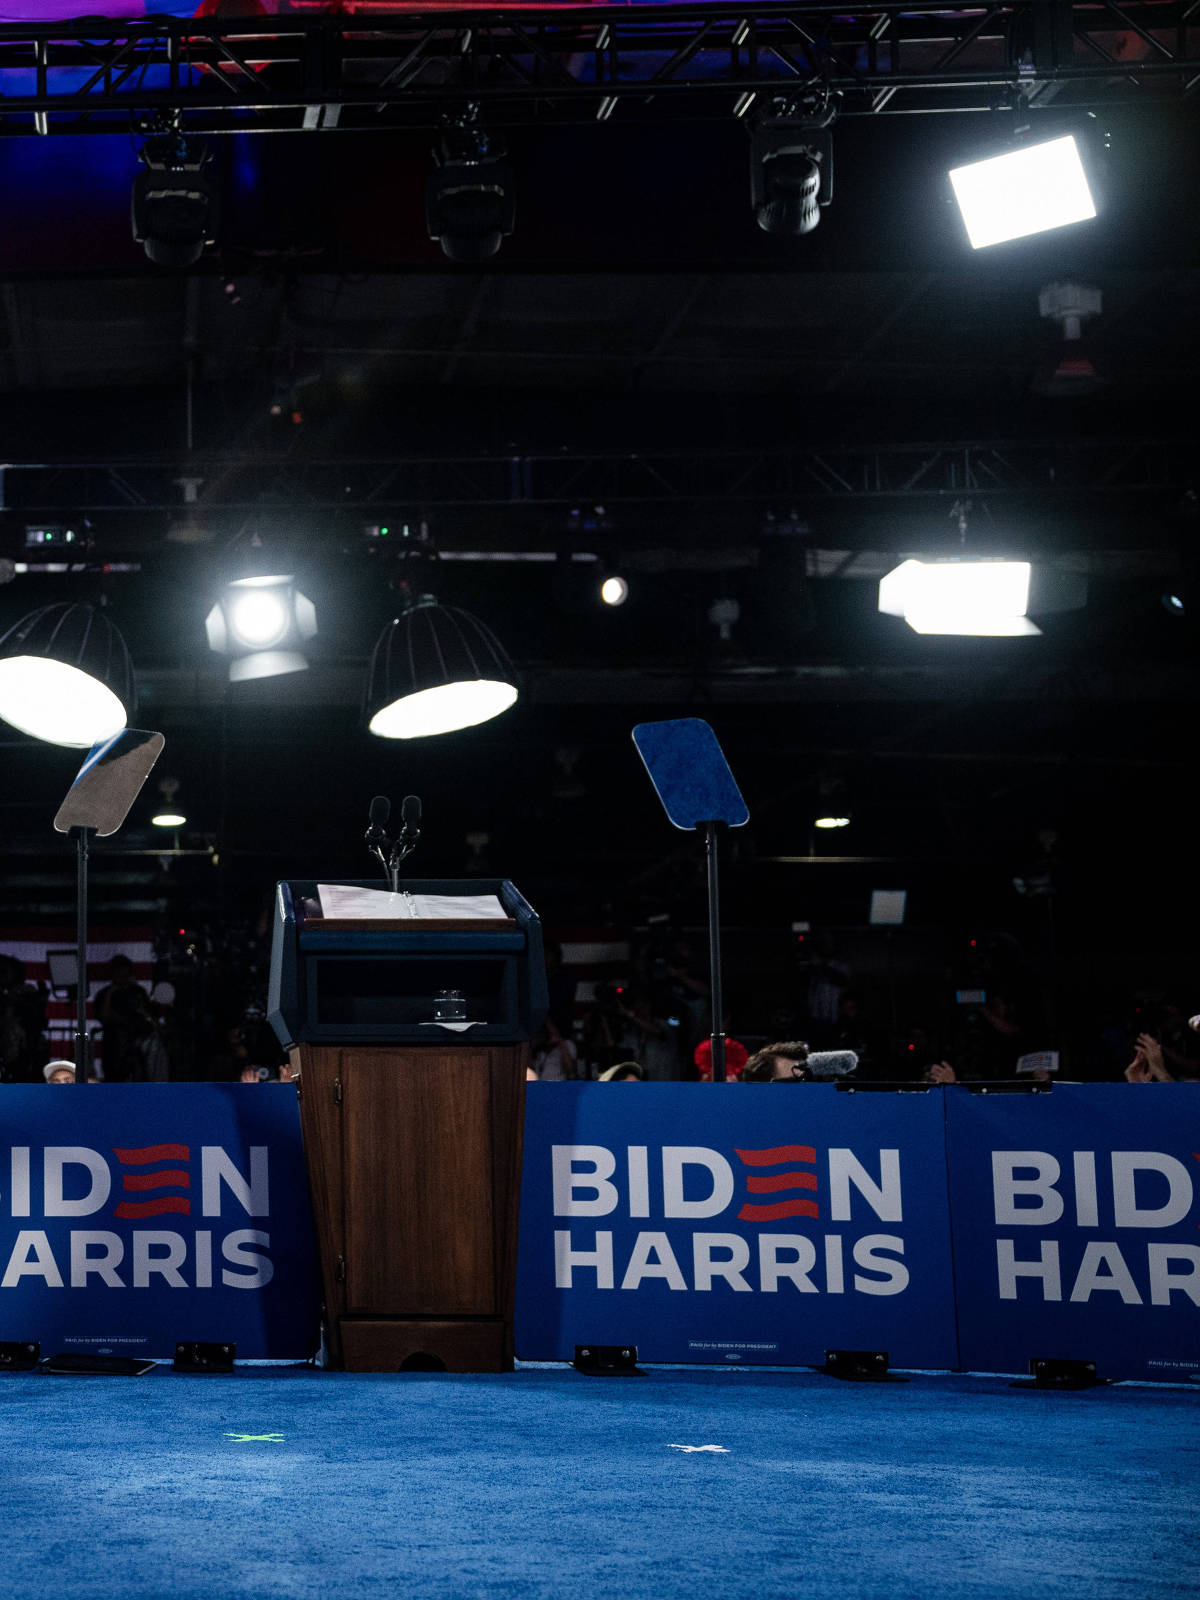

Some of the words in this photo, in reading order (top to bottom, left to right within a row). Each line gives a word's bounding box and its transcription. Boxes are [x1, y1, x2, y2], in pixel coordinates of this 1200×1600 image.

[551, 1144, 903, 1222] BIDEN
[991, 1150, 1200, 1229] BID
[553, 1230, 910, 1296] HARRIS
[996, 1238, 1200, 1308] HAR
